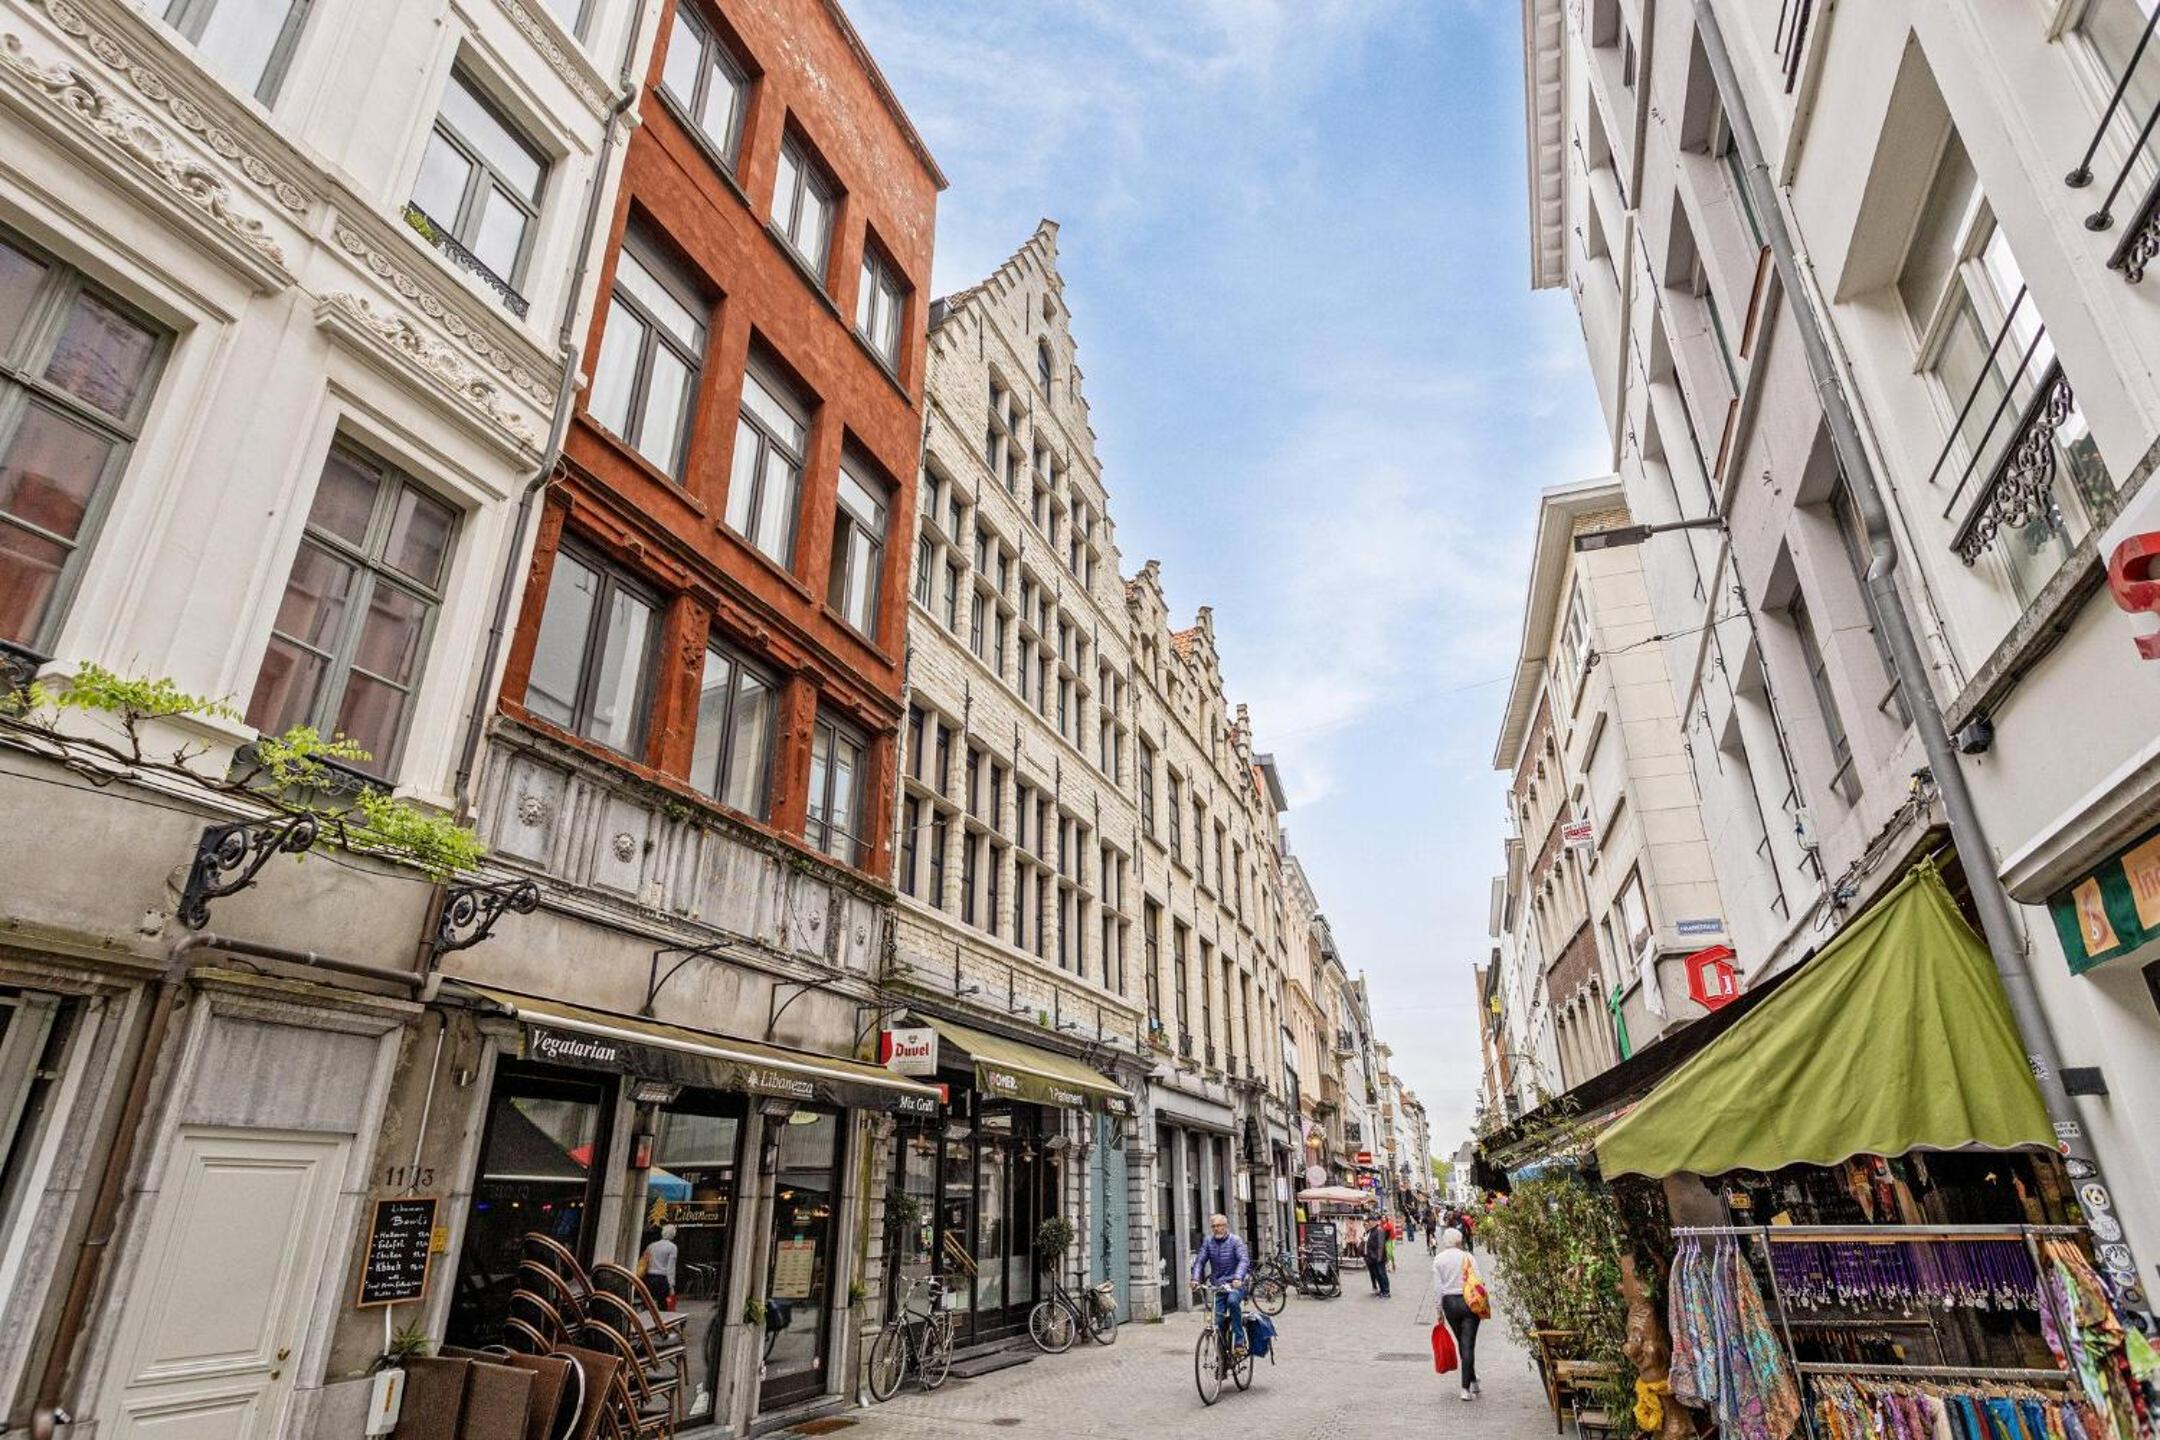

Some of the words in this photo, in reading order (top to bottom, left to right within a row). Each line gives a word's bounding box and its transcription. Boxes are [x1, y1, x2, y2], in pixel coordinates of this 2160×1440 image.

[532, 1029, 616, 1061] Vegatarian
[895, 1042, 930, 1057] Duvel
[899, 1095, 915, 1109] Mix
[916, 1098, 934, 1112] Grill
